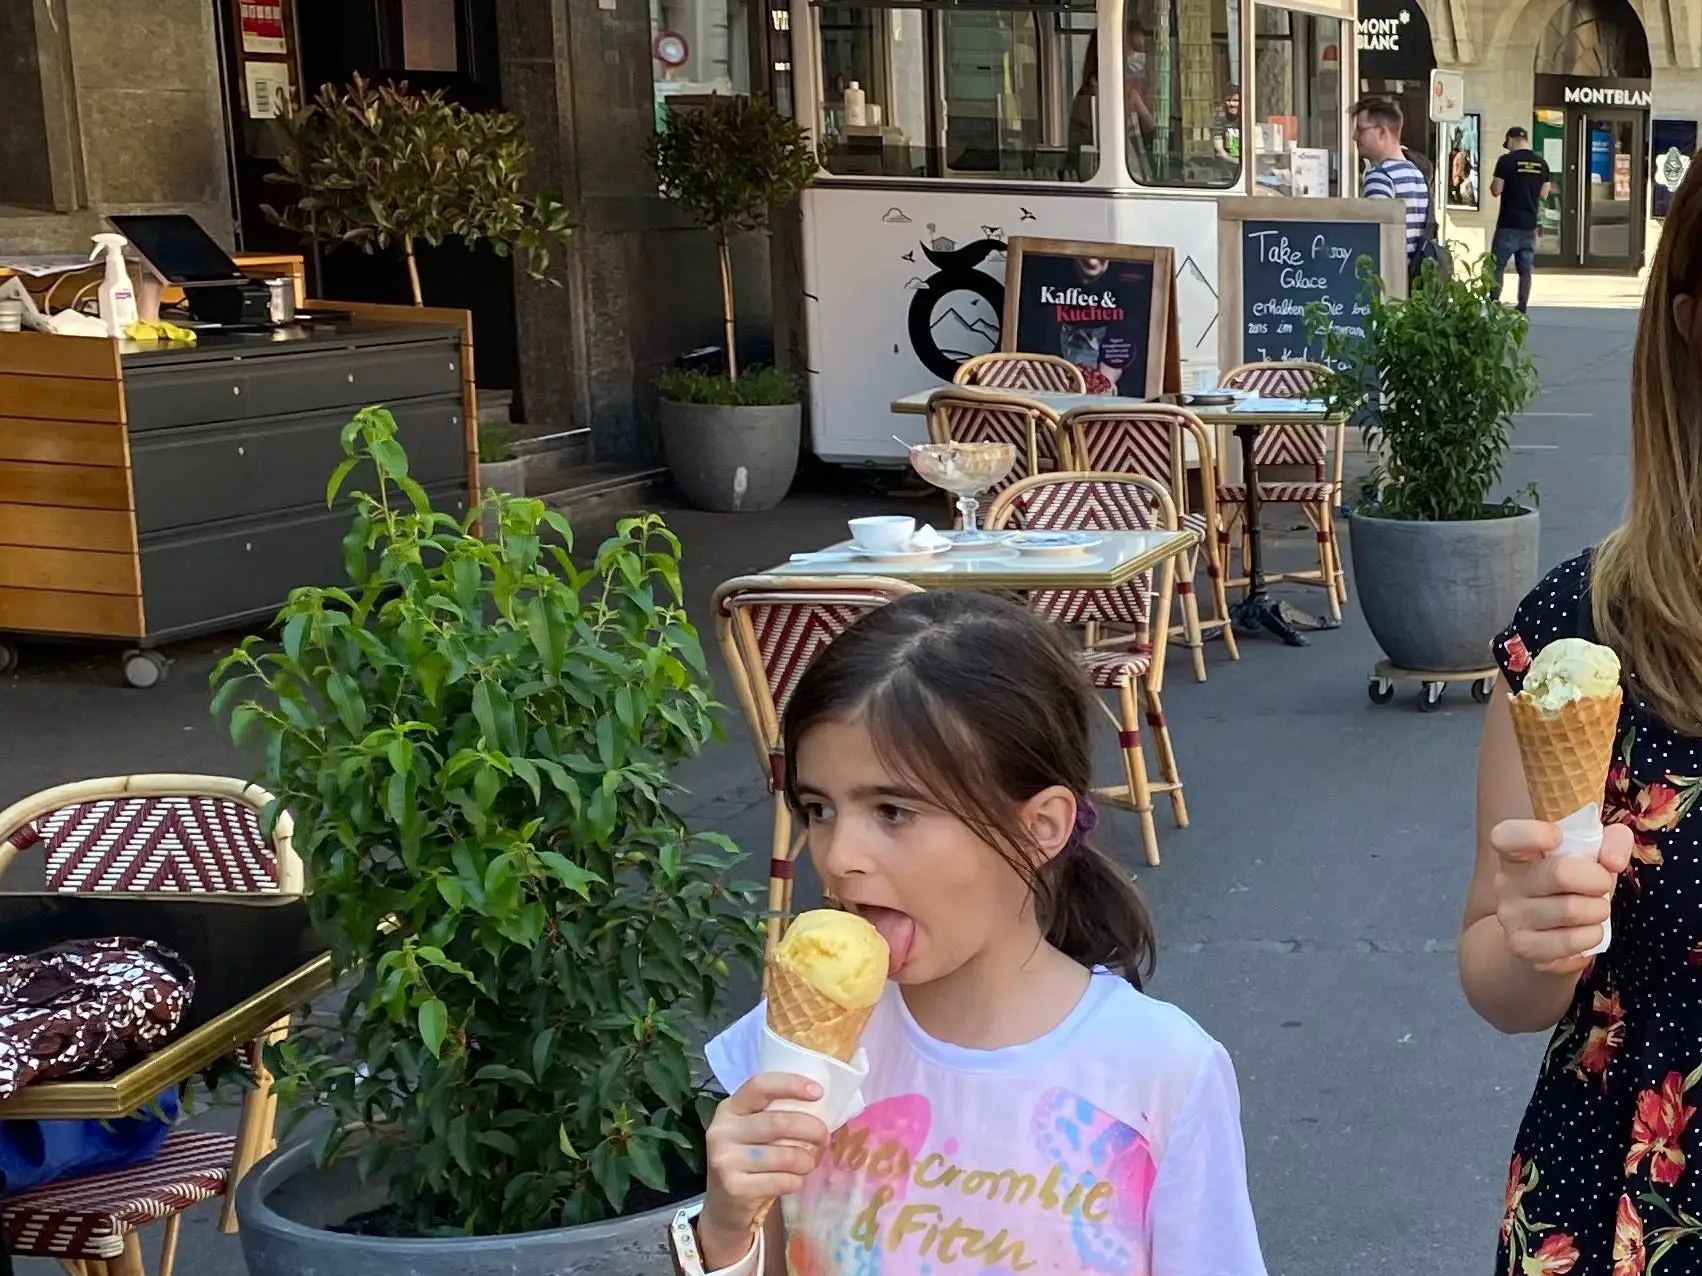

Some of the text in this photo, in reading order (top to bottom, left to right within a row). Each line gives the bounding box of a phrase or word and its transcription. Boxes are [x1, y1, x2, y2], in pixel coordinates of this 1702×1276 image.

[1357, 18, 1399, 34] MONT
[1357, 34, 1399, 51] BLANC
[1564, 86, 1652, 106] MONTBLAN
[1248, 230, 1304, 265] Take
[1280, 267, 1328, 289] Glace
[1040, 285, 1117, 308] Kaffee &
[1056, 304, 1124, 322] Kuchen
[1252, 298, 1305, 317] erhalten
[849, 1185, 894, 1251] &
